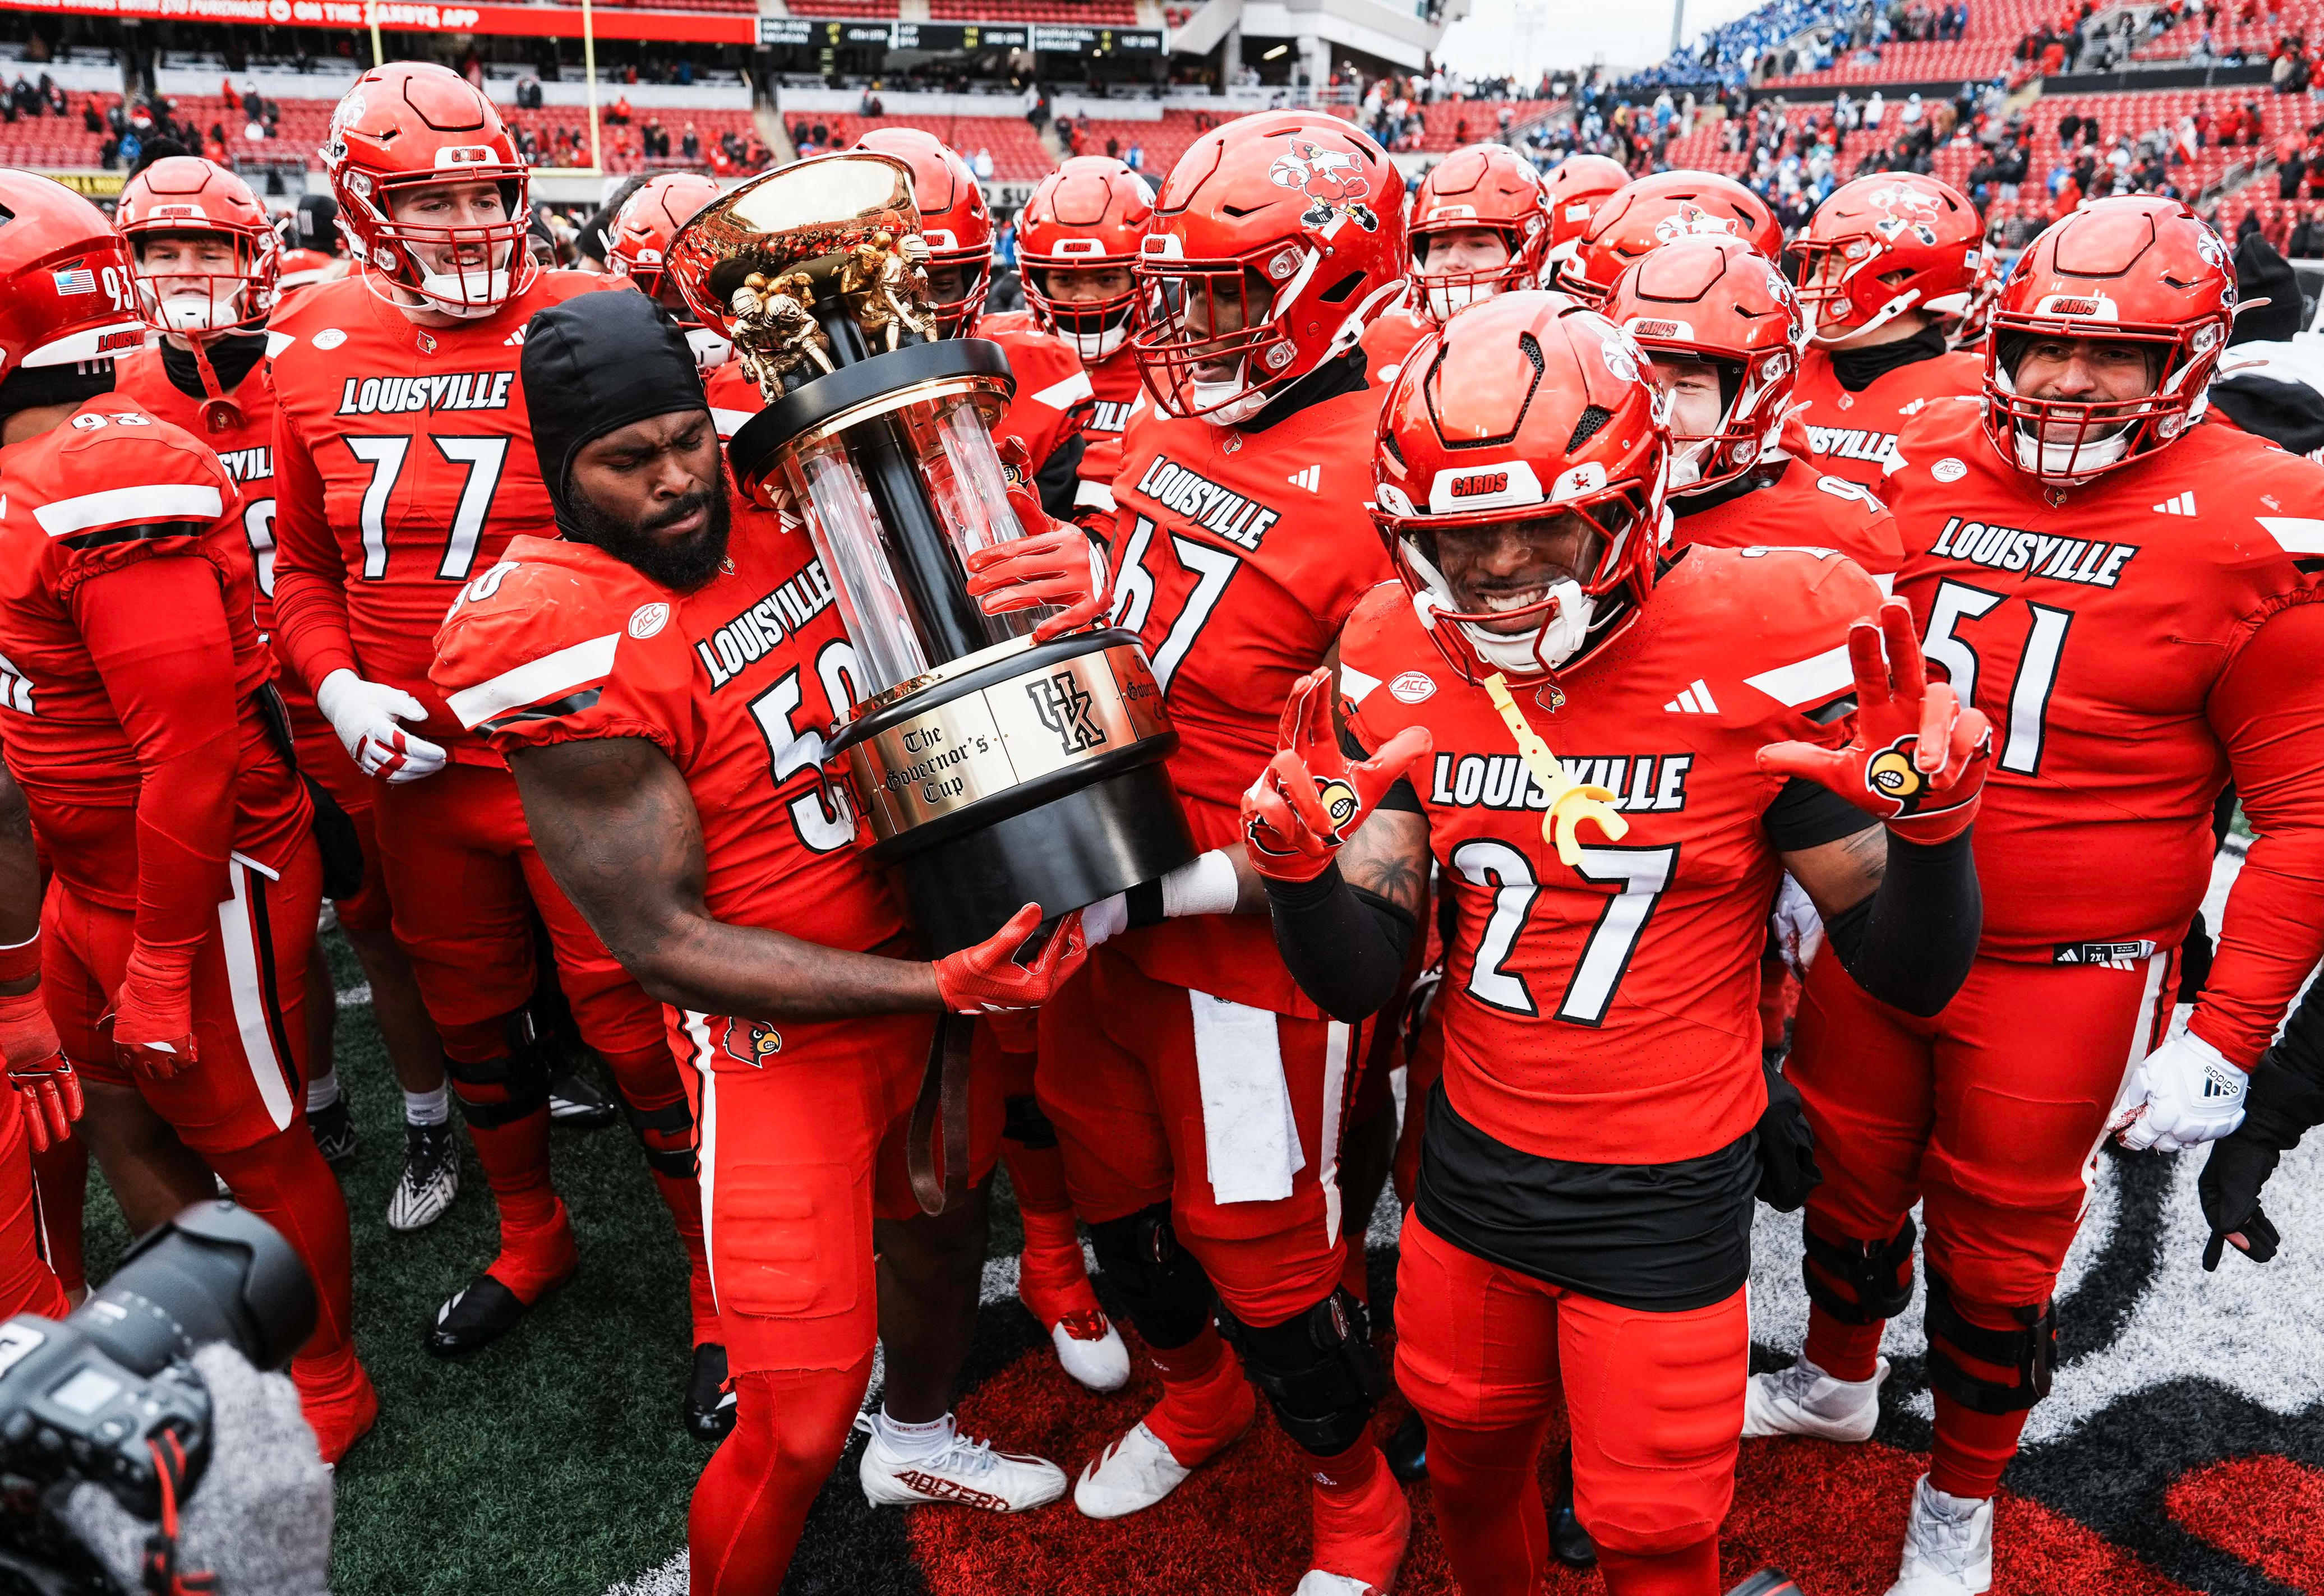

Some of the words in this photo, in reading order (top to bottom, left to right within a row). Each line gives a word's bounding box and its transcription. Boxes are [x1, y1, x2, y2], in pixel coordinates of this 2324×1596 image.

[293, 2, 323, 21] ON
[324, 3, 362, 22] THE
[442, 9, 479, 27] APP
[160, 207, 192, 216] CARDS
[923, 234, 945, 247] RDS
[1063, 242, 1092, 252] CARDS
[102, 265, 135, 311] 93
[2050, 298, 2100, 315] CARDS
[1634, 320, 1678, 337] CARDS
[334, 371, 516, 417] LOUISVILLE
[1805, 424, 1898, 464] ISVILLE
[1134, 454, 1282, 553] LOUISVILLE
[1450, 473, 1508, 498] CARDS
[1815, 475, 1889, 514] 9
[339, 434, 512, 582] 77
[1925, 516, 2142, 589] LOUISVILLE
[694, 556, 836, 695] LOUISVILLE
[1112, 511, 1242, 704] 67
[1922, 577, 2076, 778] 51
[901, 726, 943, 755] The
[884, 734, 990, 792] Governor's
[921, 774, 965, 806] Cup
[1449, 838, 1682, 1028] 27
[2090, 953, 2105, 962] 2XL
[2204, 1065, 2238, 1093] adidas
